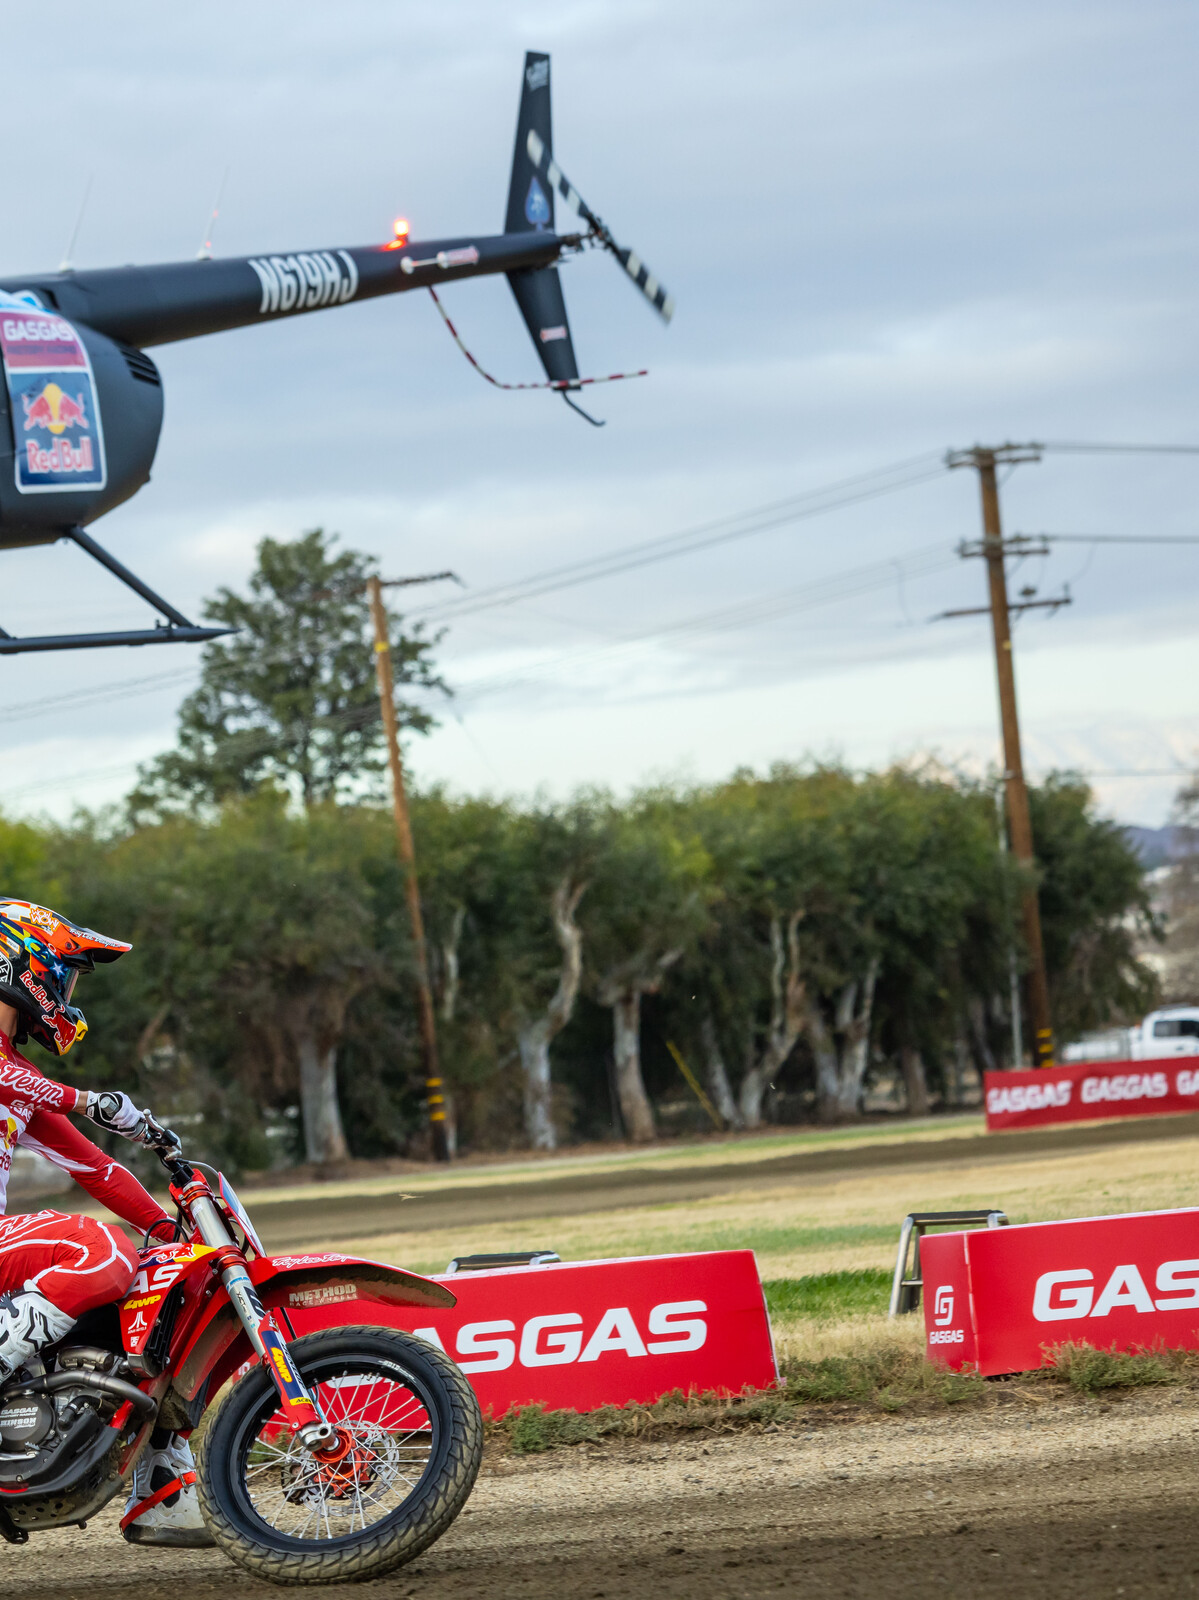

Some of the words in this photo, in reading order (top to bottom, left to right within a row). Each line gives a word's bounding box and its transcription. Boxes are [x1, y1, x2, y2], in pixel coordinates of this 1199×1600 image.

[248, 249, 359, 314] N619HJ
[3, 320, 75, 342] GASGAS
[26, 437, 60, 473] Red
[60, 436, 94, 472] Bull
[19, 969, 42, 999] Red
[34, 988, 56, 1013] Bull
[987, 1081, 1073, 1114] GASGAS
[1081, 1072, 1169, 1104] GASGAS
[124, 1295, 161, 1310] 4WP
[289, 1283, 357, 1303] METHOD
[930, 1329, 964, 1344] GASGAS
[271, 1347, 293, 1383] 4WP
[1, 1406, 39, 1415] GASGAS
